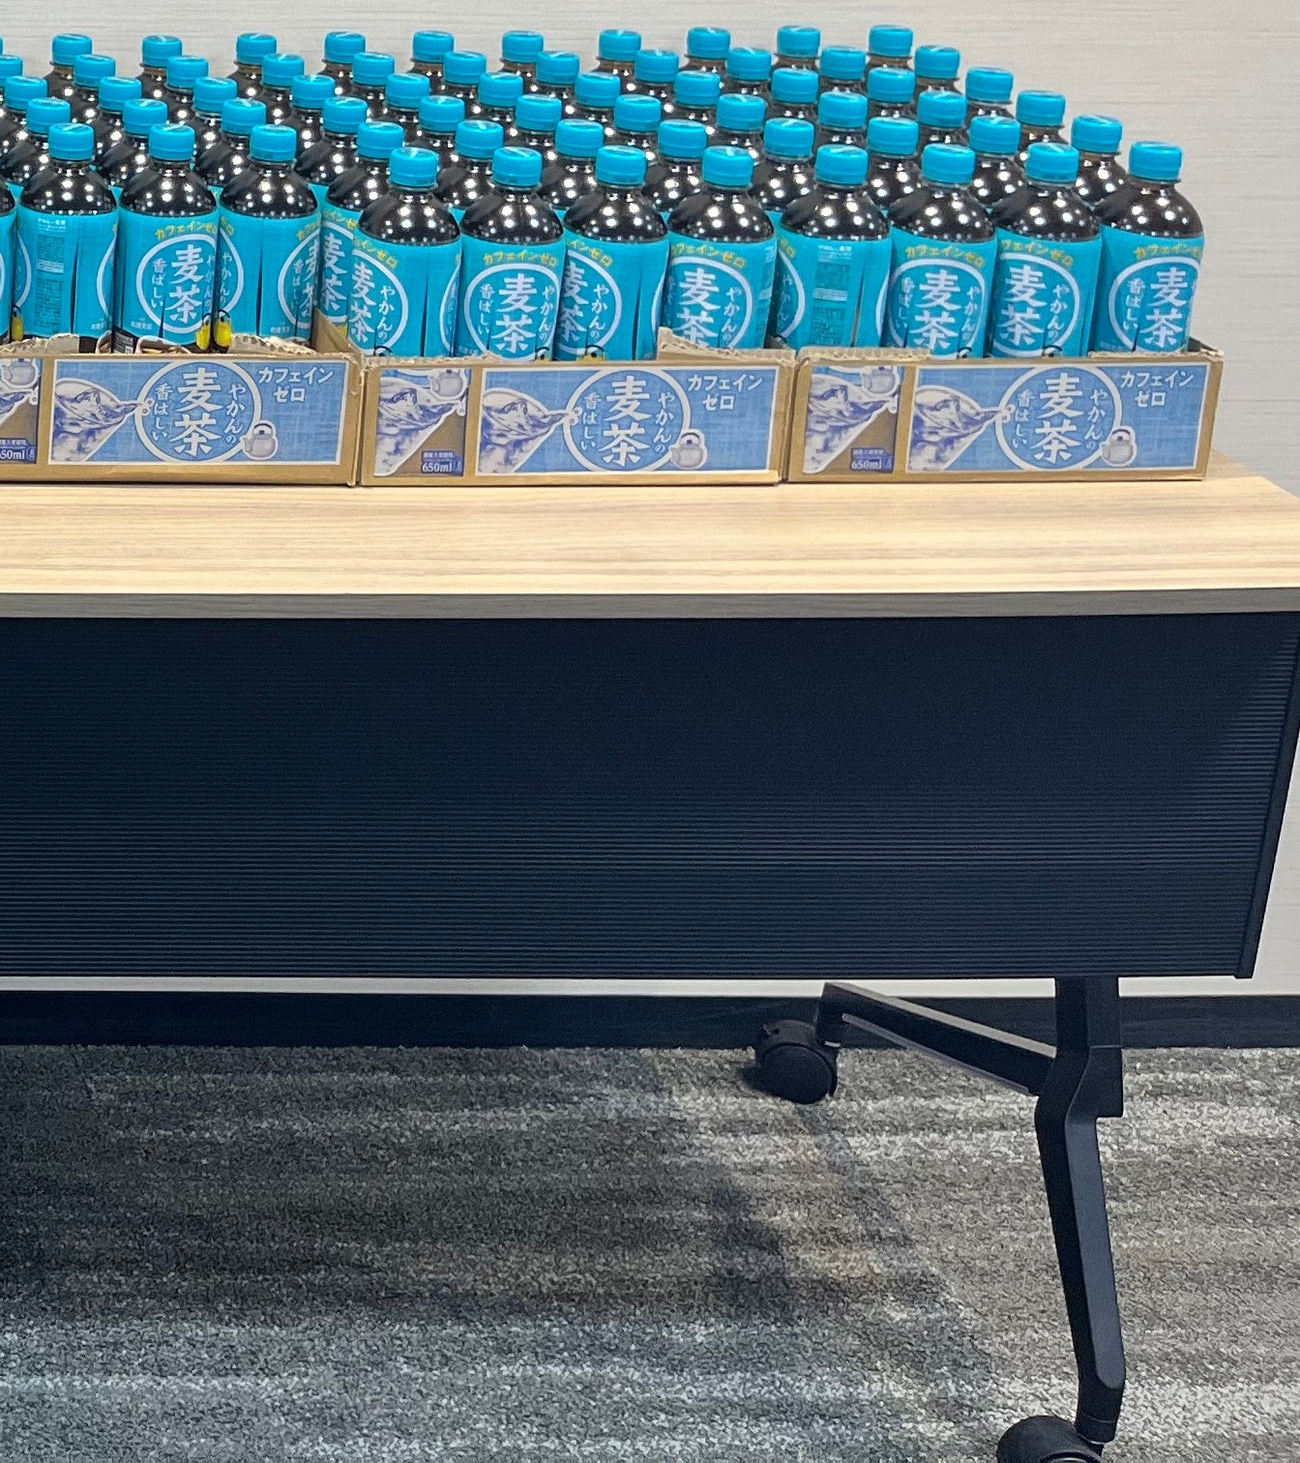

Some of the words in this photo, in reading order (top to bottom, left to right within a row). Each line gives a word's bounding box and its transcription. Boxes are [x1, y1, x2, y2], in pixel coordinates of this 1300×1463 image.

[151, 258, 167, 308] 香ばしい
[165, 243, 204, 324] 麦茶
[349, 261, 376, 343] 麦茶
[377, 284, 396, 340] やかんの
[478, 284, 496, 335] 香ばしい
[538, 285, 556, 340] やかんの
[559, 260, 589, 342] 麦茶
[589, 284, 610, 339] やかんの
[676, 267, 721, 348] 麦茶
[909, 269, 961, 350] 麦茶
[999, 264, 1047, 346] 麦茶
[1047, 284, 1070, 339] やかんの
[1122, 277, 1146, 330] 香ばしい
[1139, 266, 1188, 348] 麦茶
[491, 273, 538, 353] 麦茶
[962, 286, 981, 343] やかんの
[258, 366, 334, 385] カフェイン
[274, 387, 306, 404] ゼロ
[687, 374, 763, 393] カフェイン
[702, 394, 735, 412] ゼロ
[1120, 370, 1194, 390] カフェイン
[1134, 391, 1166, 408] ゼロ
[152, 382, 171, 441] 香ばしい
[172, 367, 222, 457] 麦茶
[224, 382, 247, 444] やかんの
[580, 391, 601, 452] 香ばしい
[602, 375, 651, 467] 麦茶
[652, 392, 676, 454] やかんの
[1012, 389, 1035, 449] 香ばしい
[1034, 372, 1083, 464] 麦茶
[1086, 388, 1109, 450] やかんの
[422, 461, 452, 473] 650ml
